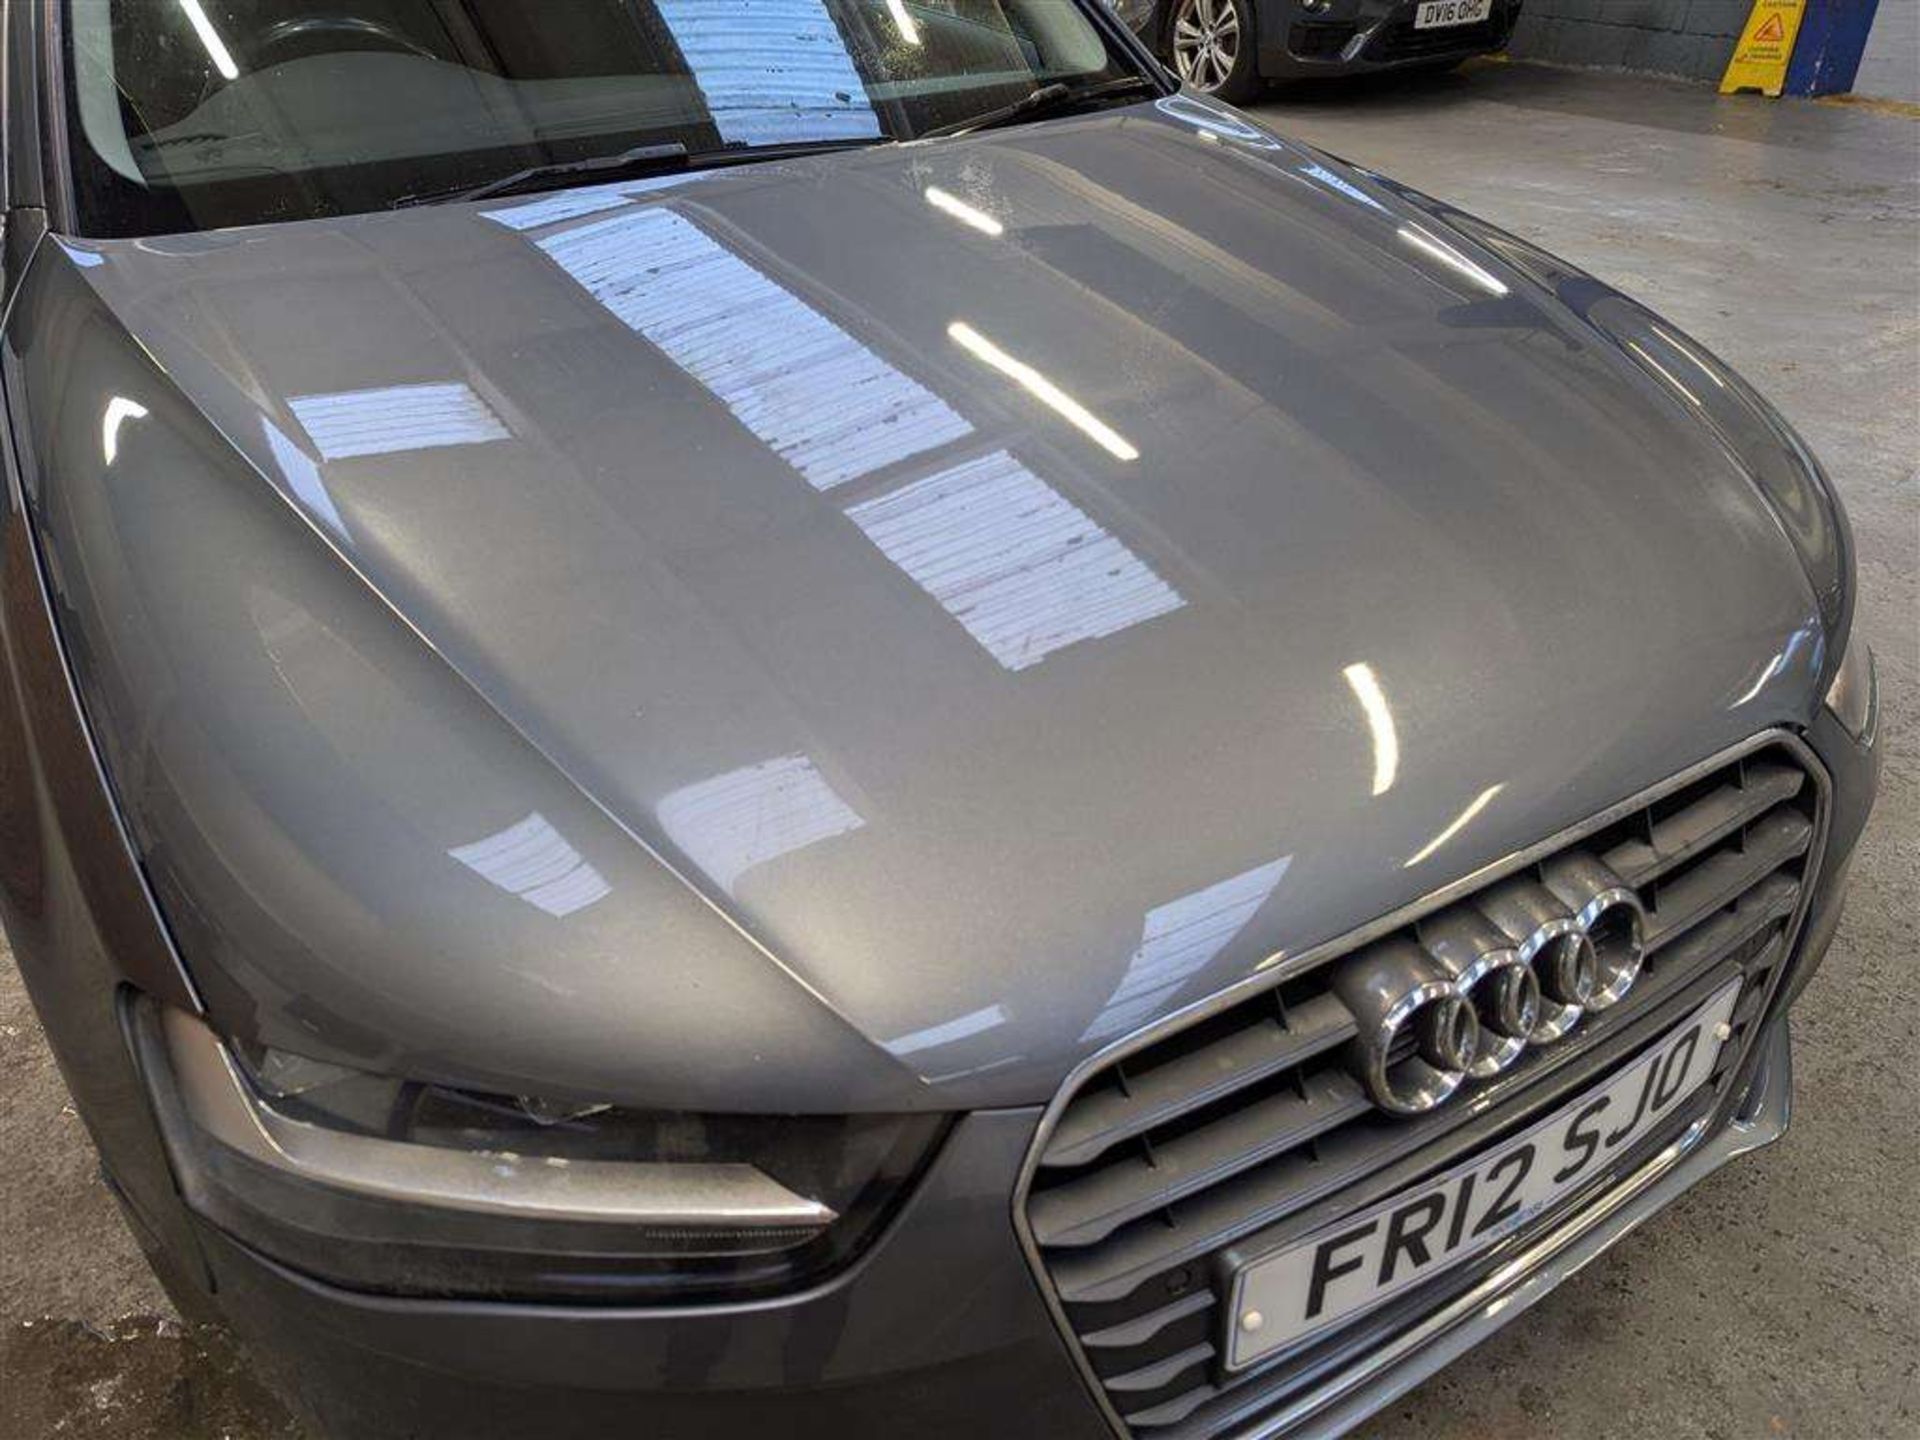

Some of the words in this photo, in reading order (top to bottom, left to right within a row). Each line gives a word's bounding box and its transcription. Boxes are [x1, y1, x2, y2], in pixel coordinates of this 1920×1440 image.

[1424, 3, 1457, 24] DV16
[1305, 1144, 1537, 1320] FR12
[1553, 1023, 1701, 1184] SJO
